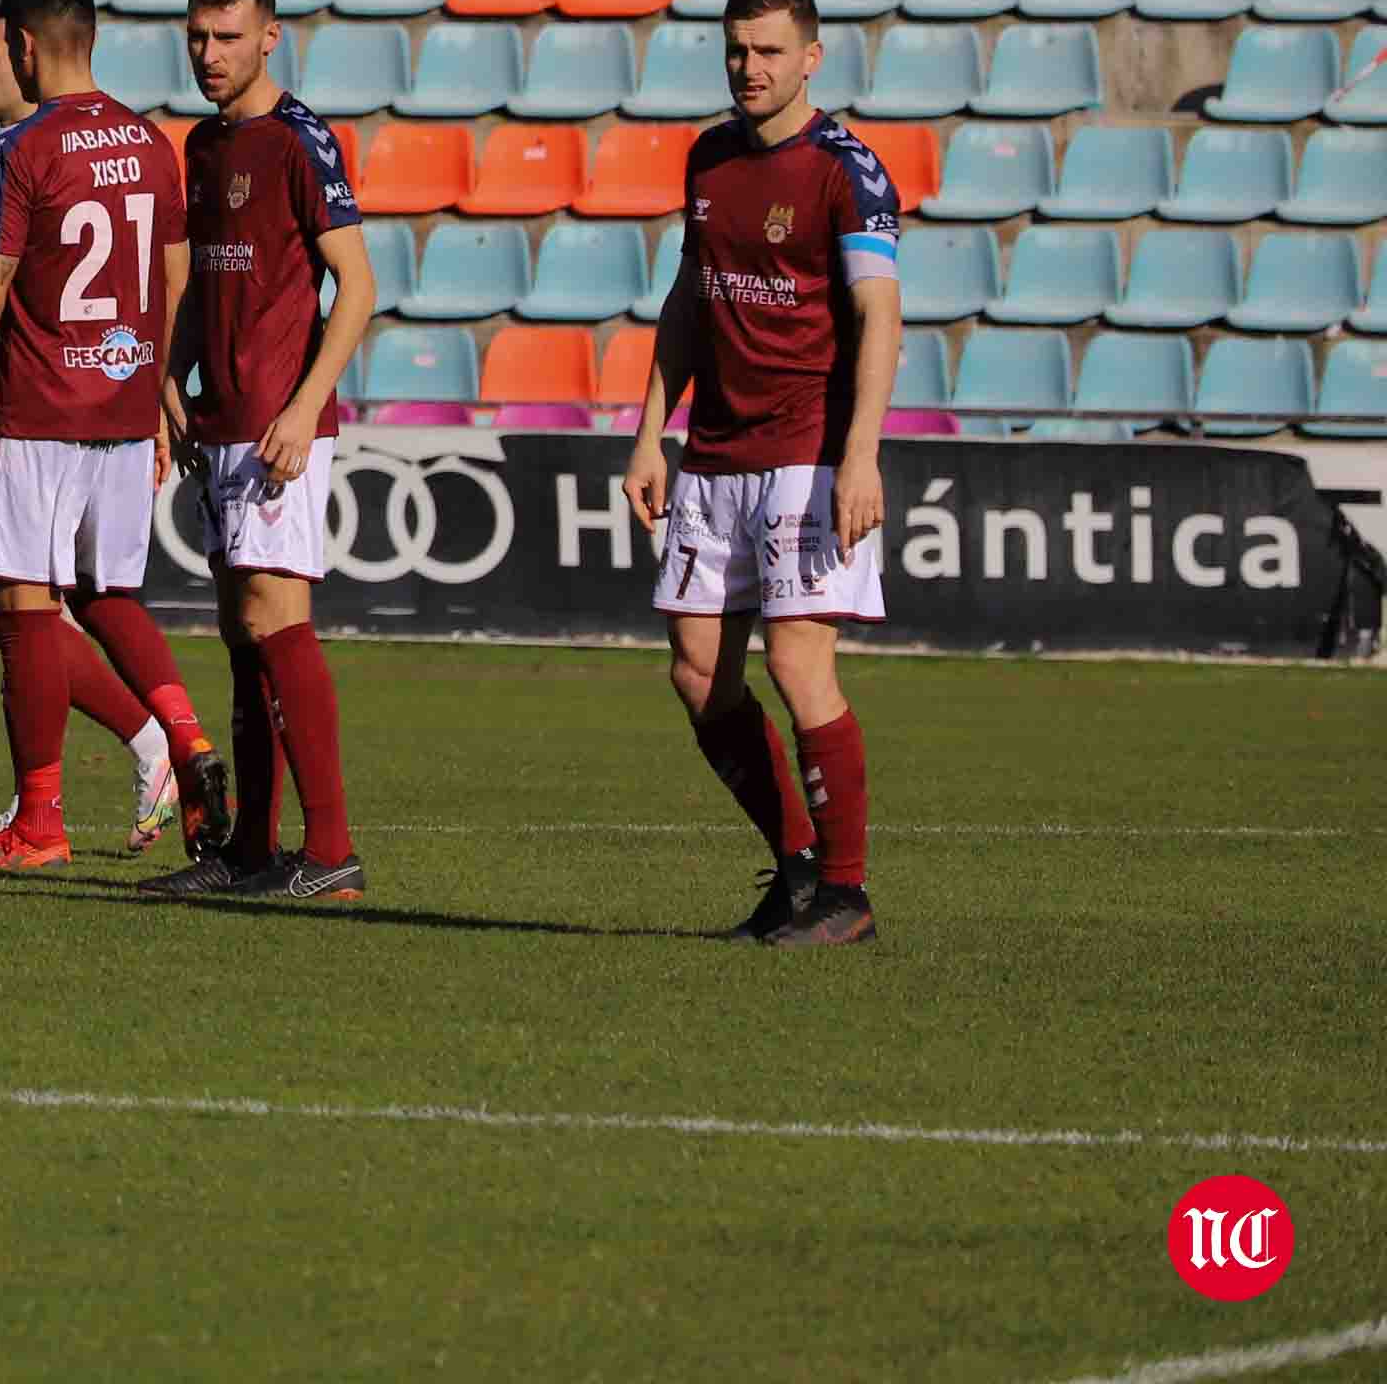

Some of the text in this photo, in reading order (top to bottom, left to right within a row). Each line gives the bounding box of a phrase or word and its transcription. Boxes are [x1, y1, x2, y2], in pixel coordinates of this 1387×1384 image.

[66, 124, 153, 153] ABANCA
[89, 155, 142, 189] XISCO
[59, 192, 155, 322] 21
[555, 471, 1303, 590] Hántica
[674, 544, 698, 601] 7
